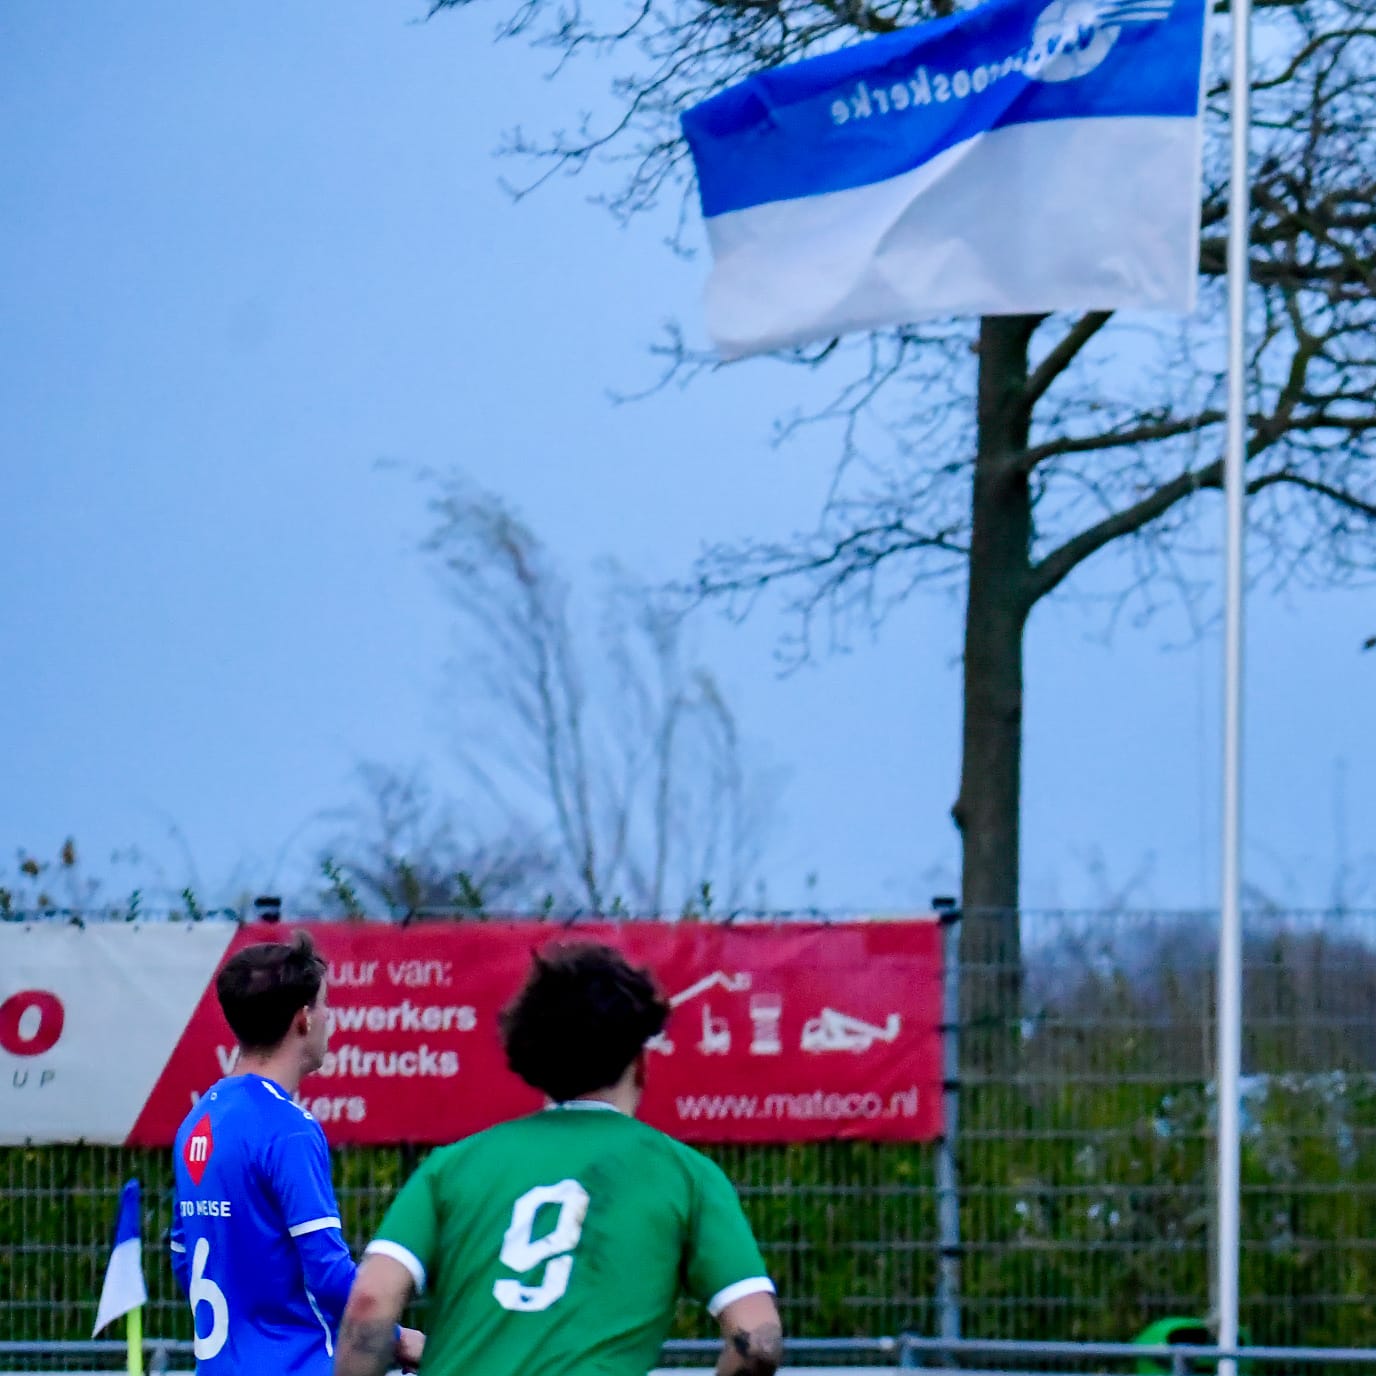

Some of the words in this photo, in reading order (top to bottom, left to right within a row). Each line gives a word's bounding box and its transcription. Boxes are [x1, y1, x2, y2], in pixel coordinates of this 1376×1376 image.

[387, 960, 453, 988] van:
[326, 1000, 477, 1038] gwerkers
[675, 1086, 918, 1120] www.mateco.nl
[493, 1178, 590, 1312] 9
[189, 1237, 229, 1361] 6
